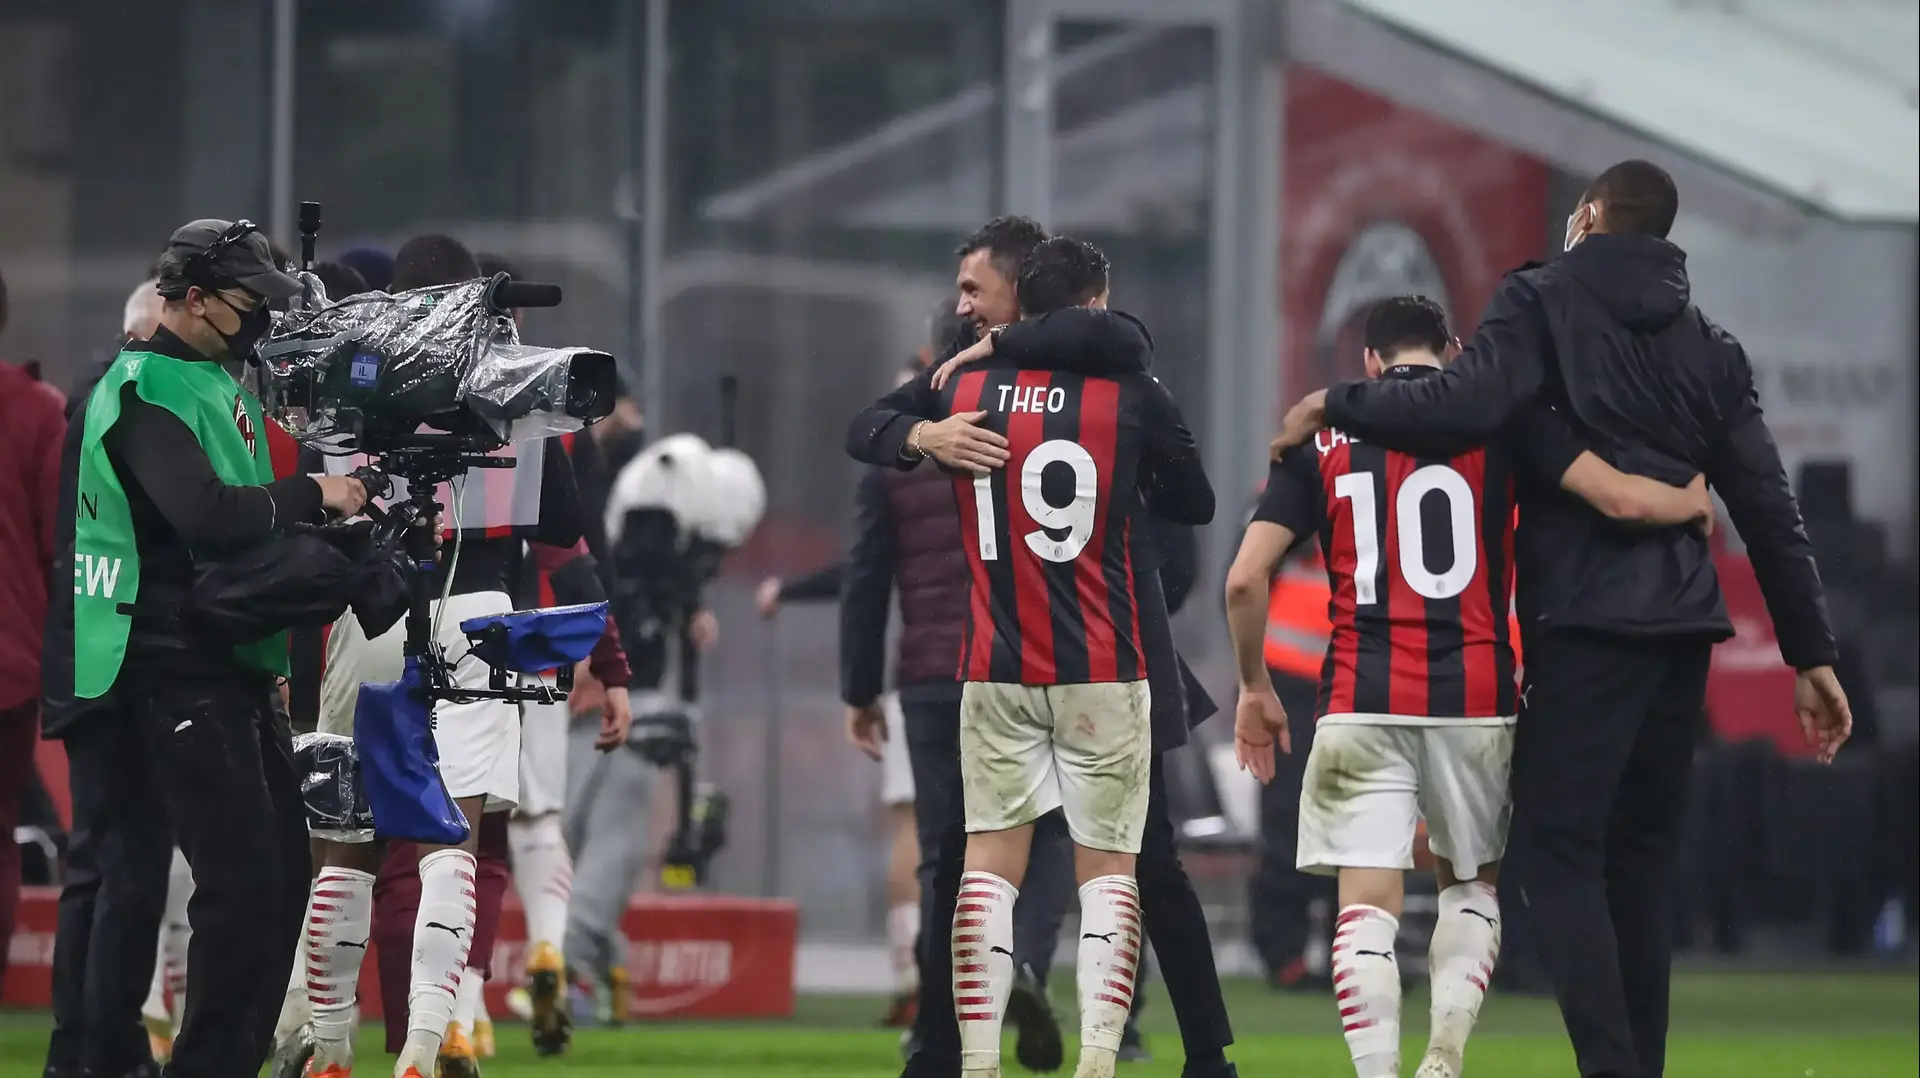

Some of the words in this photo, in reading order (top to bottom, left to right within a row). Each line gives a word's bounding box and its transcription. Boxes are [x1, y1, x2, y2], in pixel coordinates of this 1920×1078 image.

[998, 385, 1065, 413] THEO
[973, 439, 1097, 563] 19
[1335, 464, 1477, 605] 10
